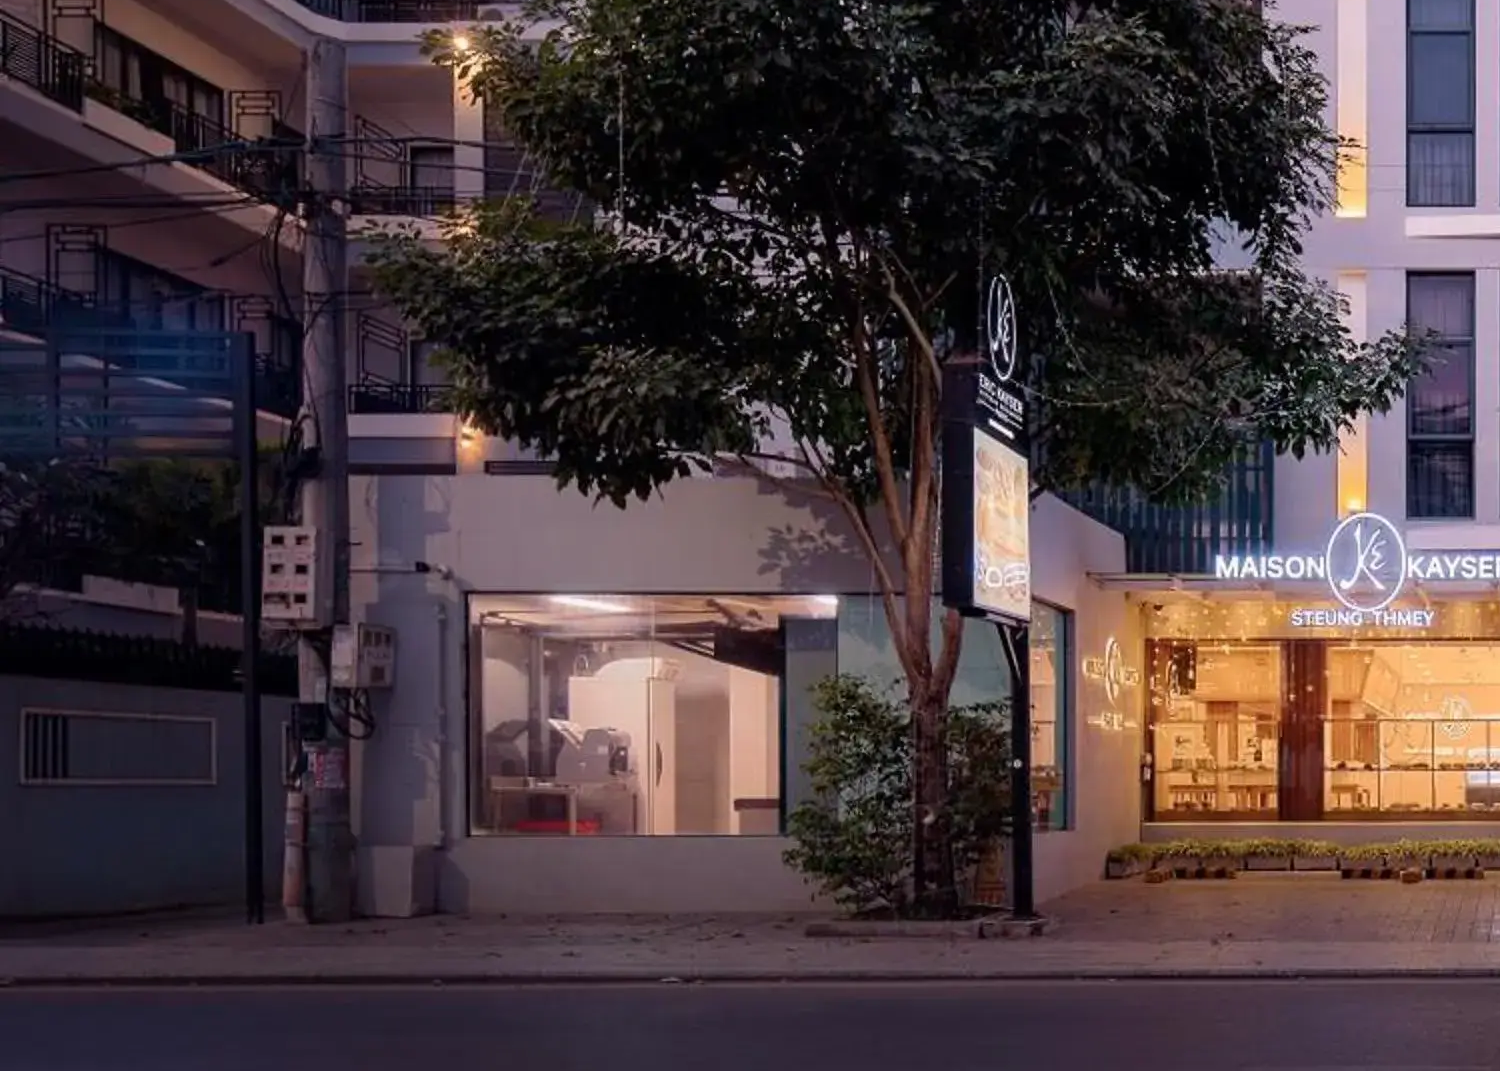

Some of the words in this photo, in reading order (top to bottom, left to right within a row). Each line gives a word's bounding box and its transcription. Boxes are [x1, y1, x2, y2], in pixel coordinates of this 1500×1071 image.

[1215, 555, 1326, 579] MAISON
[1291, 610, 1363, 626] STEUNG
[1373, 610, 1436, 626] THMEY
